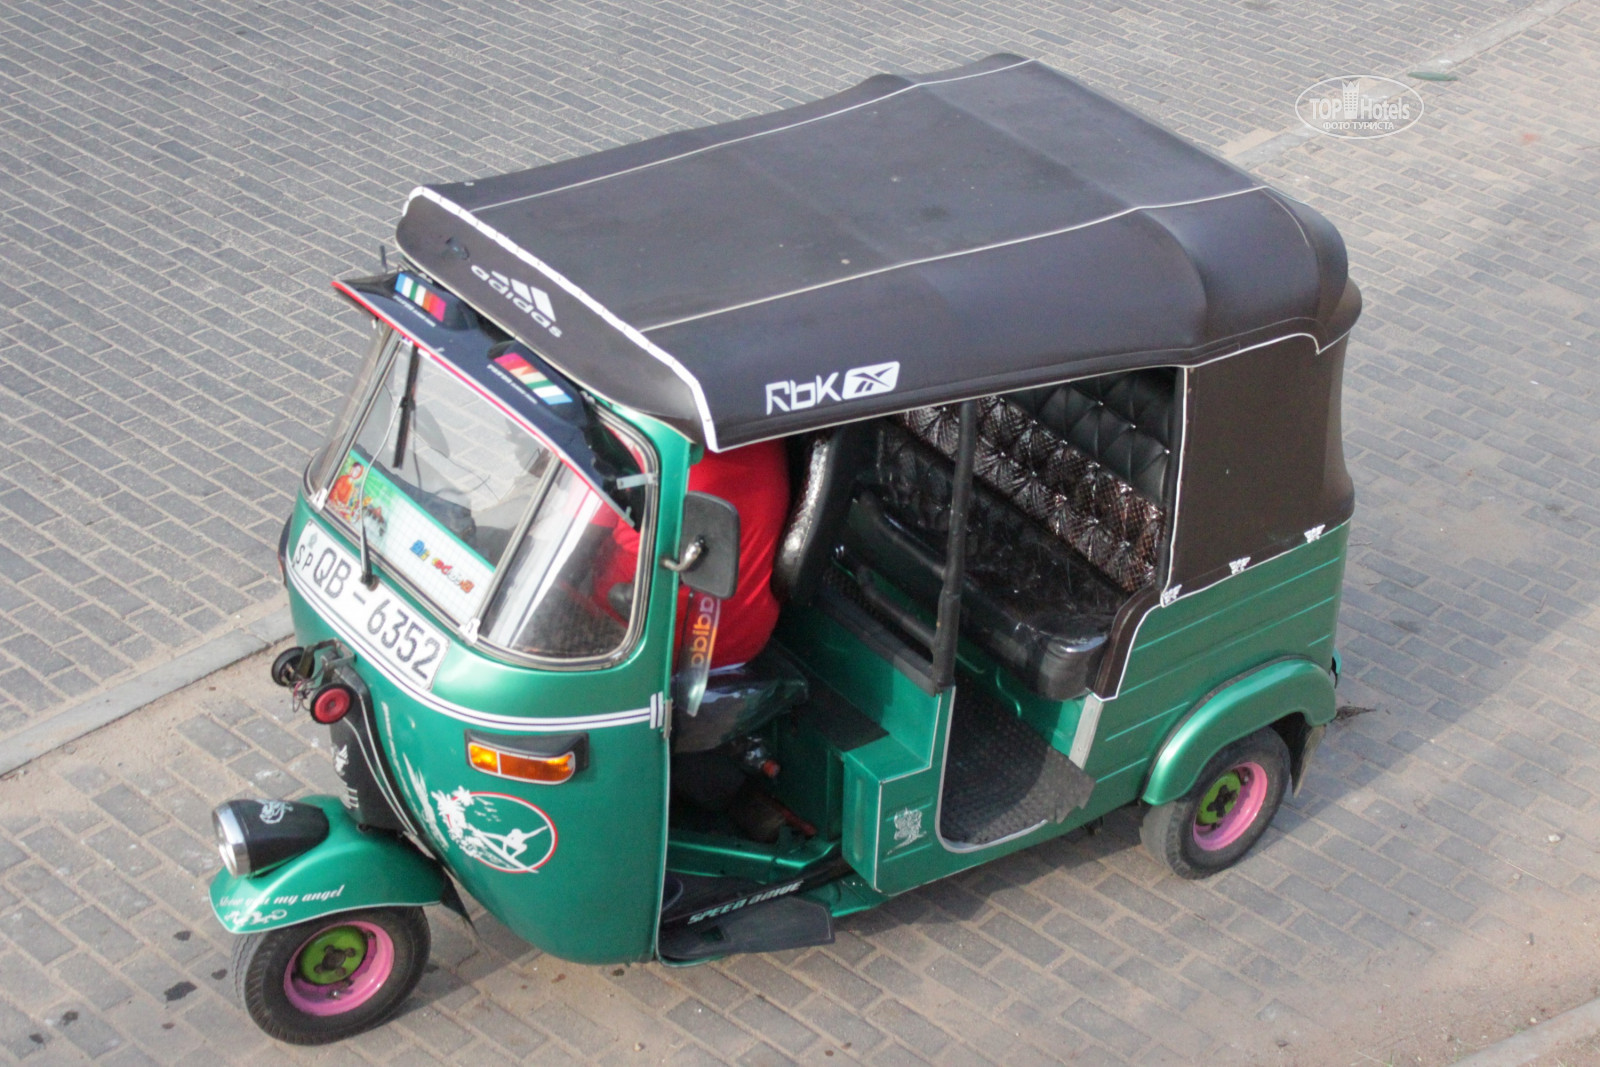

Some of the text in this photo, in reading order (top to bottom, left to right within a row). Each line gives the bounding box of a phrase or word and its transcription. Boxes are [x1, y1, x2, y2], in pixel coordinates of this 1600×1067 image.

[471, 265, 562, 338] adidas
[273, 894, 299, 906] my
[302, 884, 345, 902] angel
[687, 898, 748, 925] SPEED
